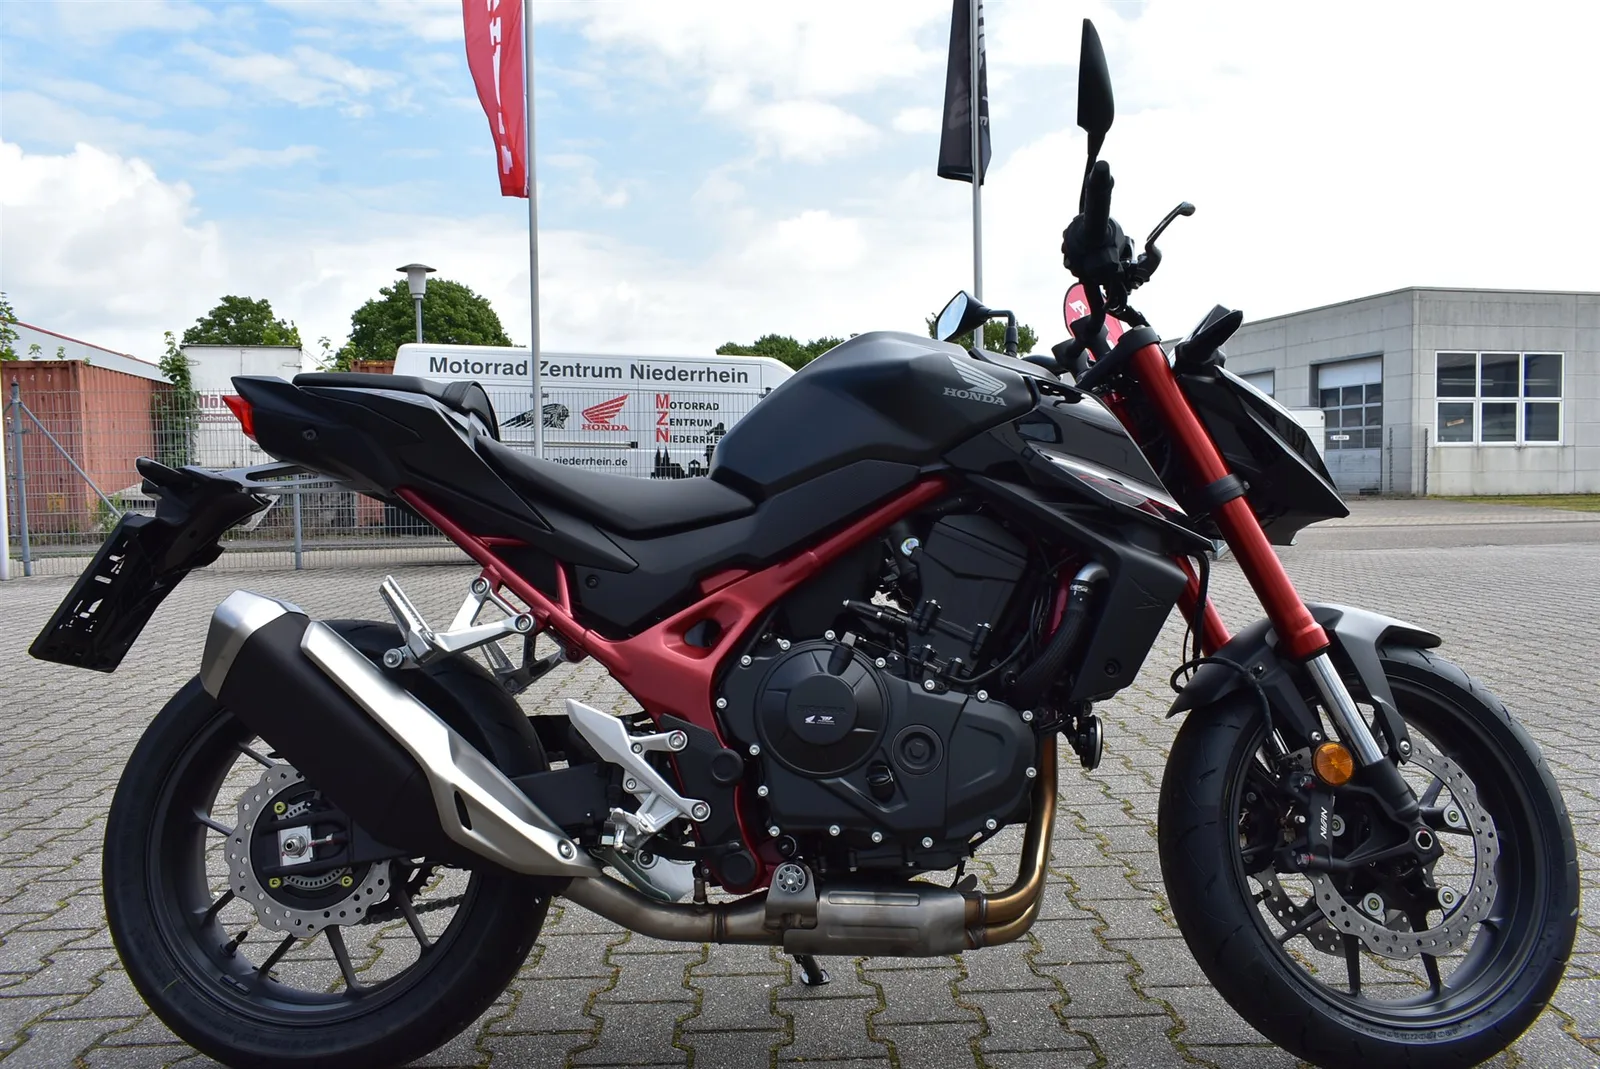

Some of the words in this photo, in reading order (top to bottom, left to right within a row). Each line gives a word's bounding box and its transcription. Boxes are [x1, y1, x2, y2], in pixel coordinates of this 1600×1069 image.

[429, 356, 528, 376] Motorrad
[540, 360, 623, 379] Zentrum
[630, 364, 749, 384] Niederrhein
[656, 393, 719, 411] MOTORRAD
[942, 386, 1007, 407] HONDA
[656, 411, 713, 427] ZENTRUM
[581, 424, 629, 432] HONDA
[656, 427, 722, 443] NIEDERRHE
[545, 456, 628, 466] niederrhein.de
